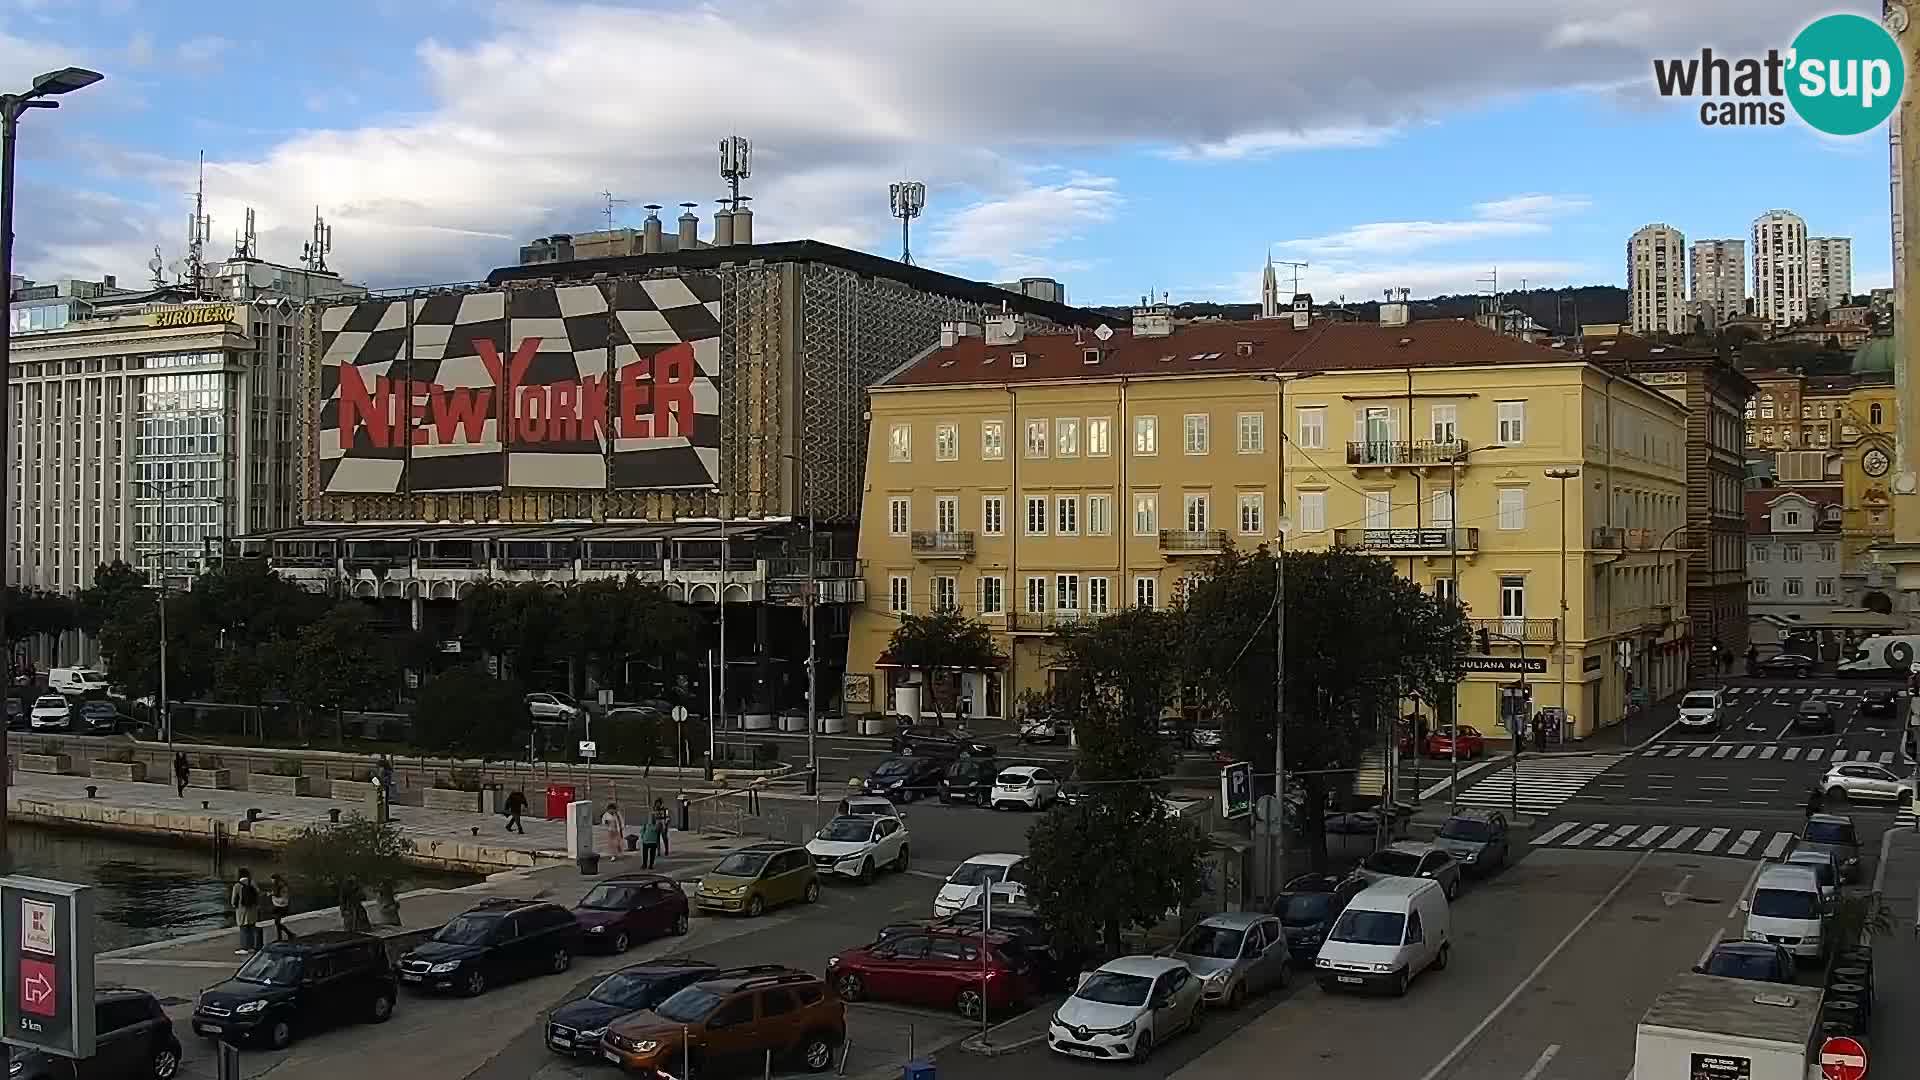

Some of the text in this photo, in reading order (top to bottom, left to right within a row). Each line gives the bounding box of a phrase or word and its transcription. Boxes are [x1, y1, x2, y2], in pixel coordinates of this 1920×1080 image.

[1459, 661, 1541, 670] JULIANA NAILS
[21, 1017, 42, 1033] 5 km
